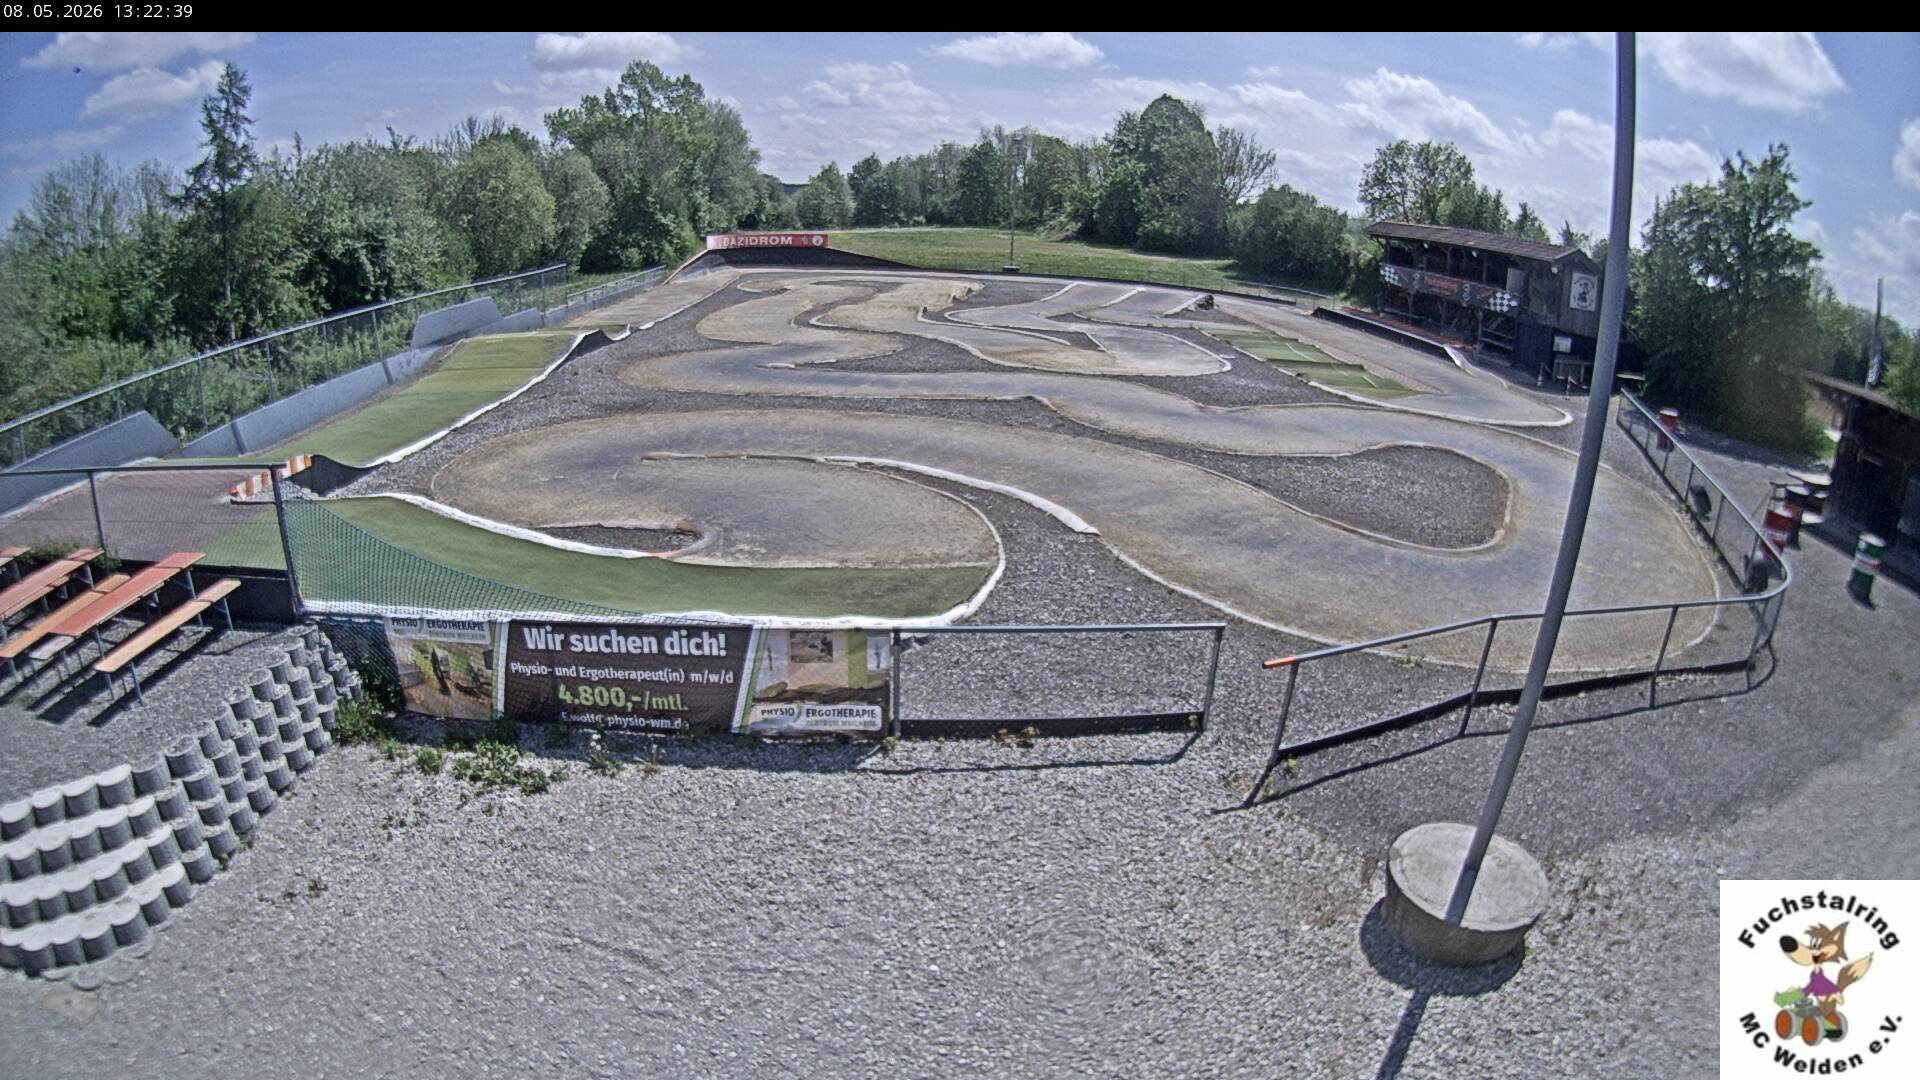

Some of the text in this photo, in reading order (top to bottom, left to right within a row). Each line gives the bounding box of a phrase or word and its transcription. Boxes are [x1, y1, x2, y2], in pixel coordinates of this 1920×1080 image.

[523, 625, 727, 657] Wir suchen dich!
[510, 662, 735, 685] Physio- und Ergotherapeut(in) m/w/d
[760, 706, 877, 719] PHYSIO ERGOTHERAPIE
